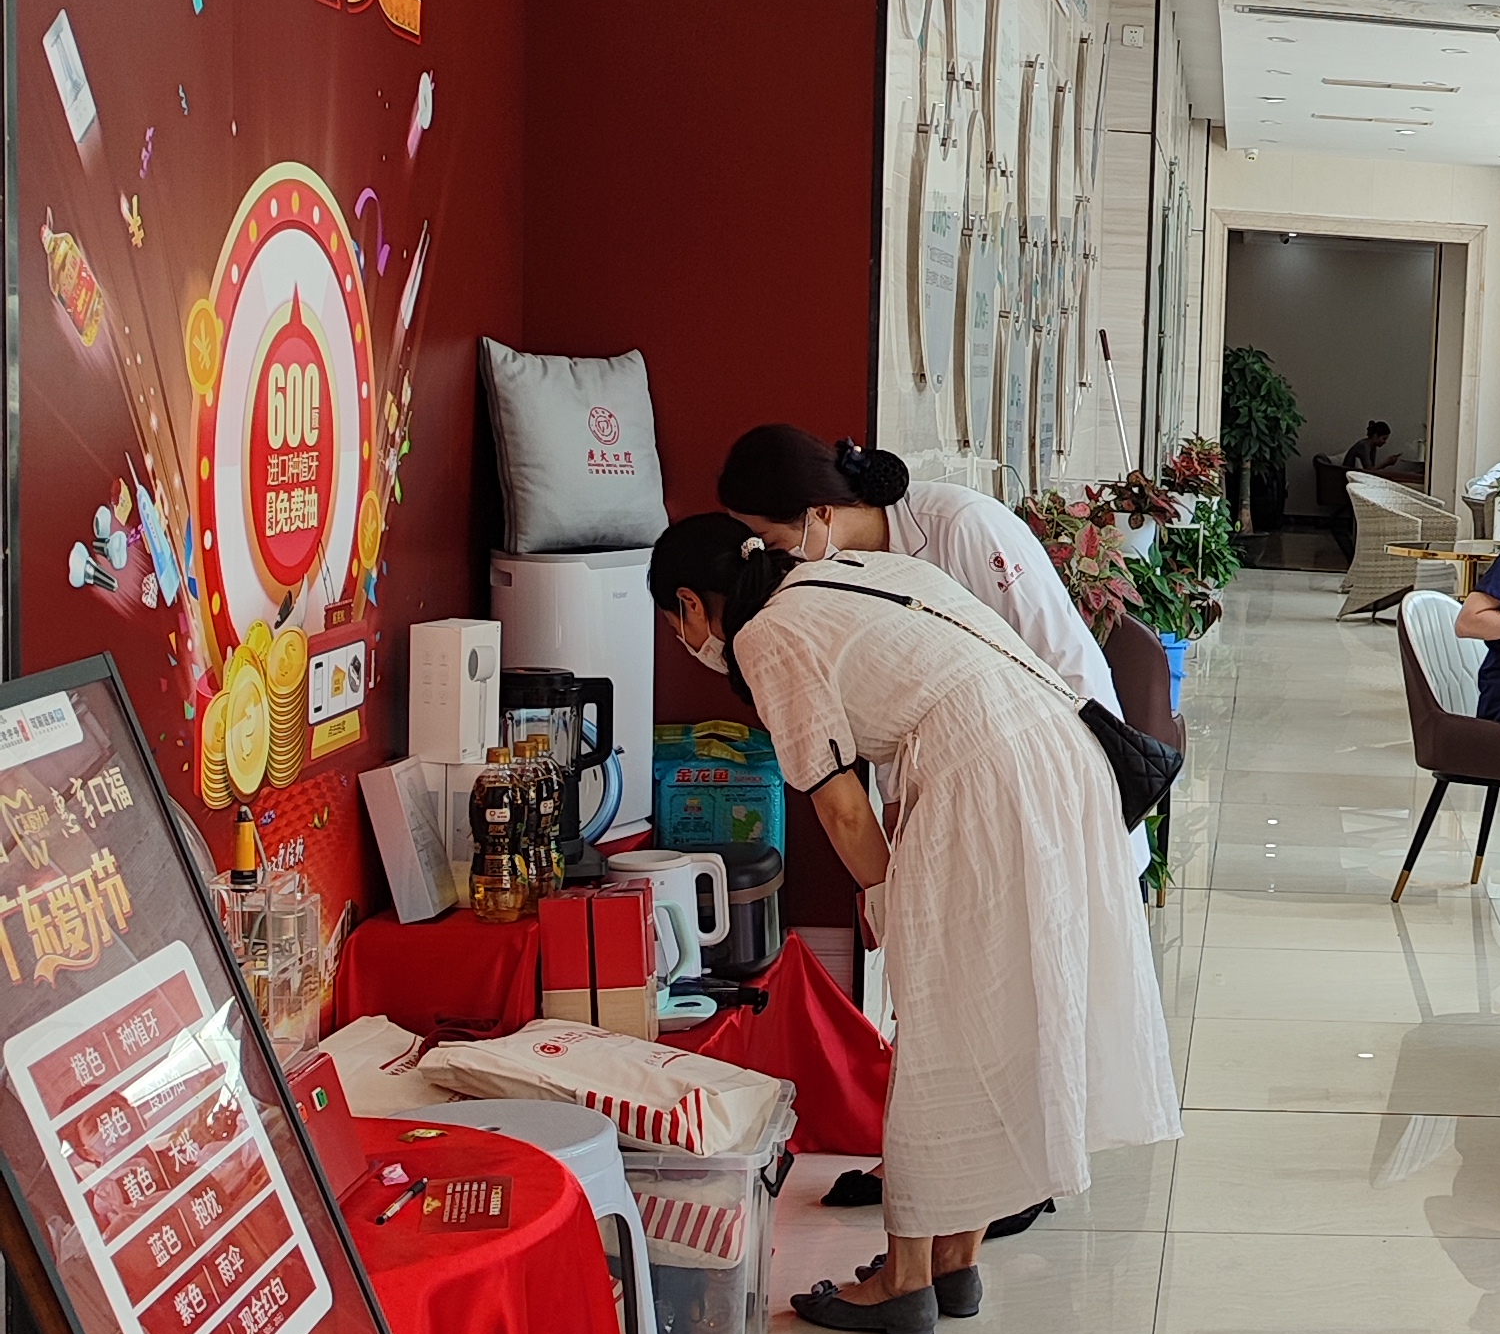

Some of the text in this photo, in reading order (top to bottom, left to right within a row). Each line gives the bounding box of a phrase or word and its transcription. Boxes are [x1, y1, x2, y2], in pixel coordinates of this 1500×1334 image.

[267, 451, 320, 486] 进口种植牙
[675, 768, 730, 783] 金龙鱼
[70, 1008, 160, 1087] 橙色 种植牙
[96, 1106, 131, 1147] 绿色
[122, 1127, 199, 1208] 黄色 大米
[147, 1186, 222, 1268] 蓝色 抱枕
[174, 1244, 245, 1327] 紫色 雨伞
